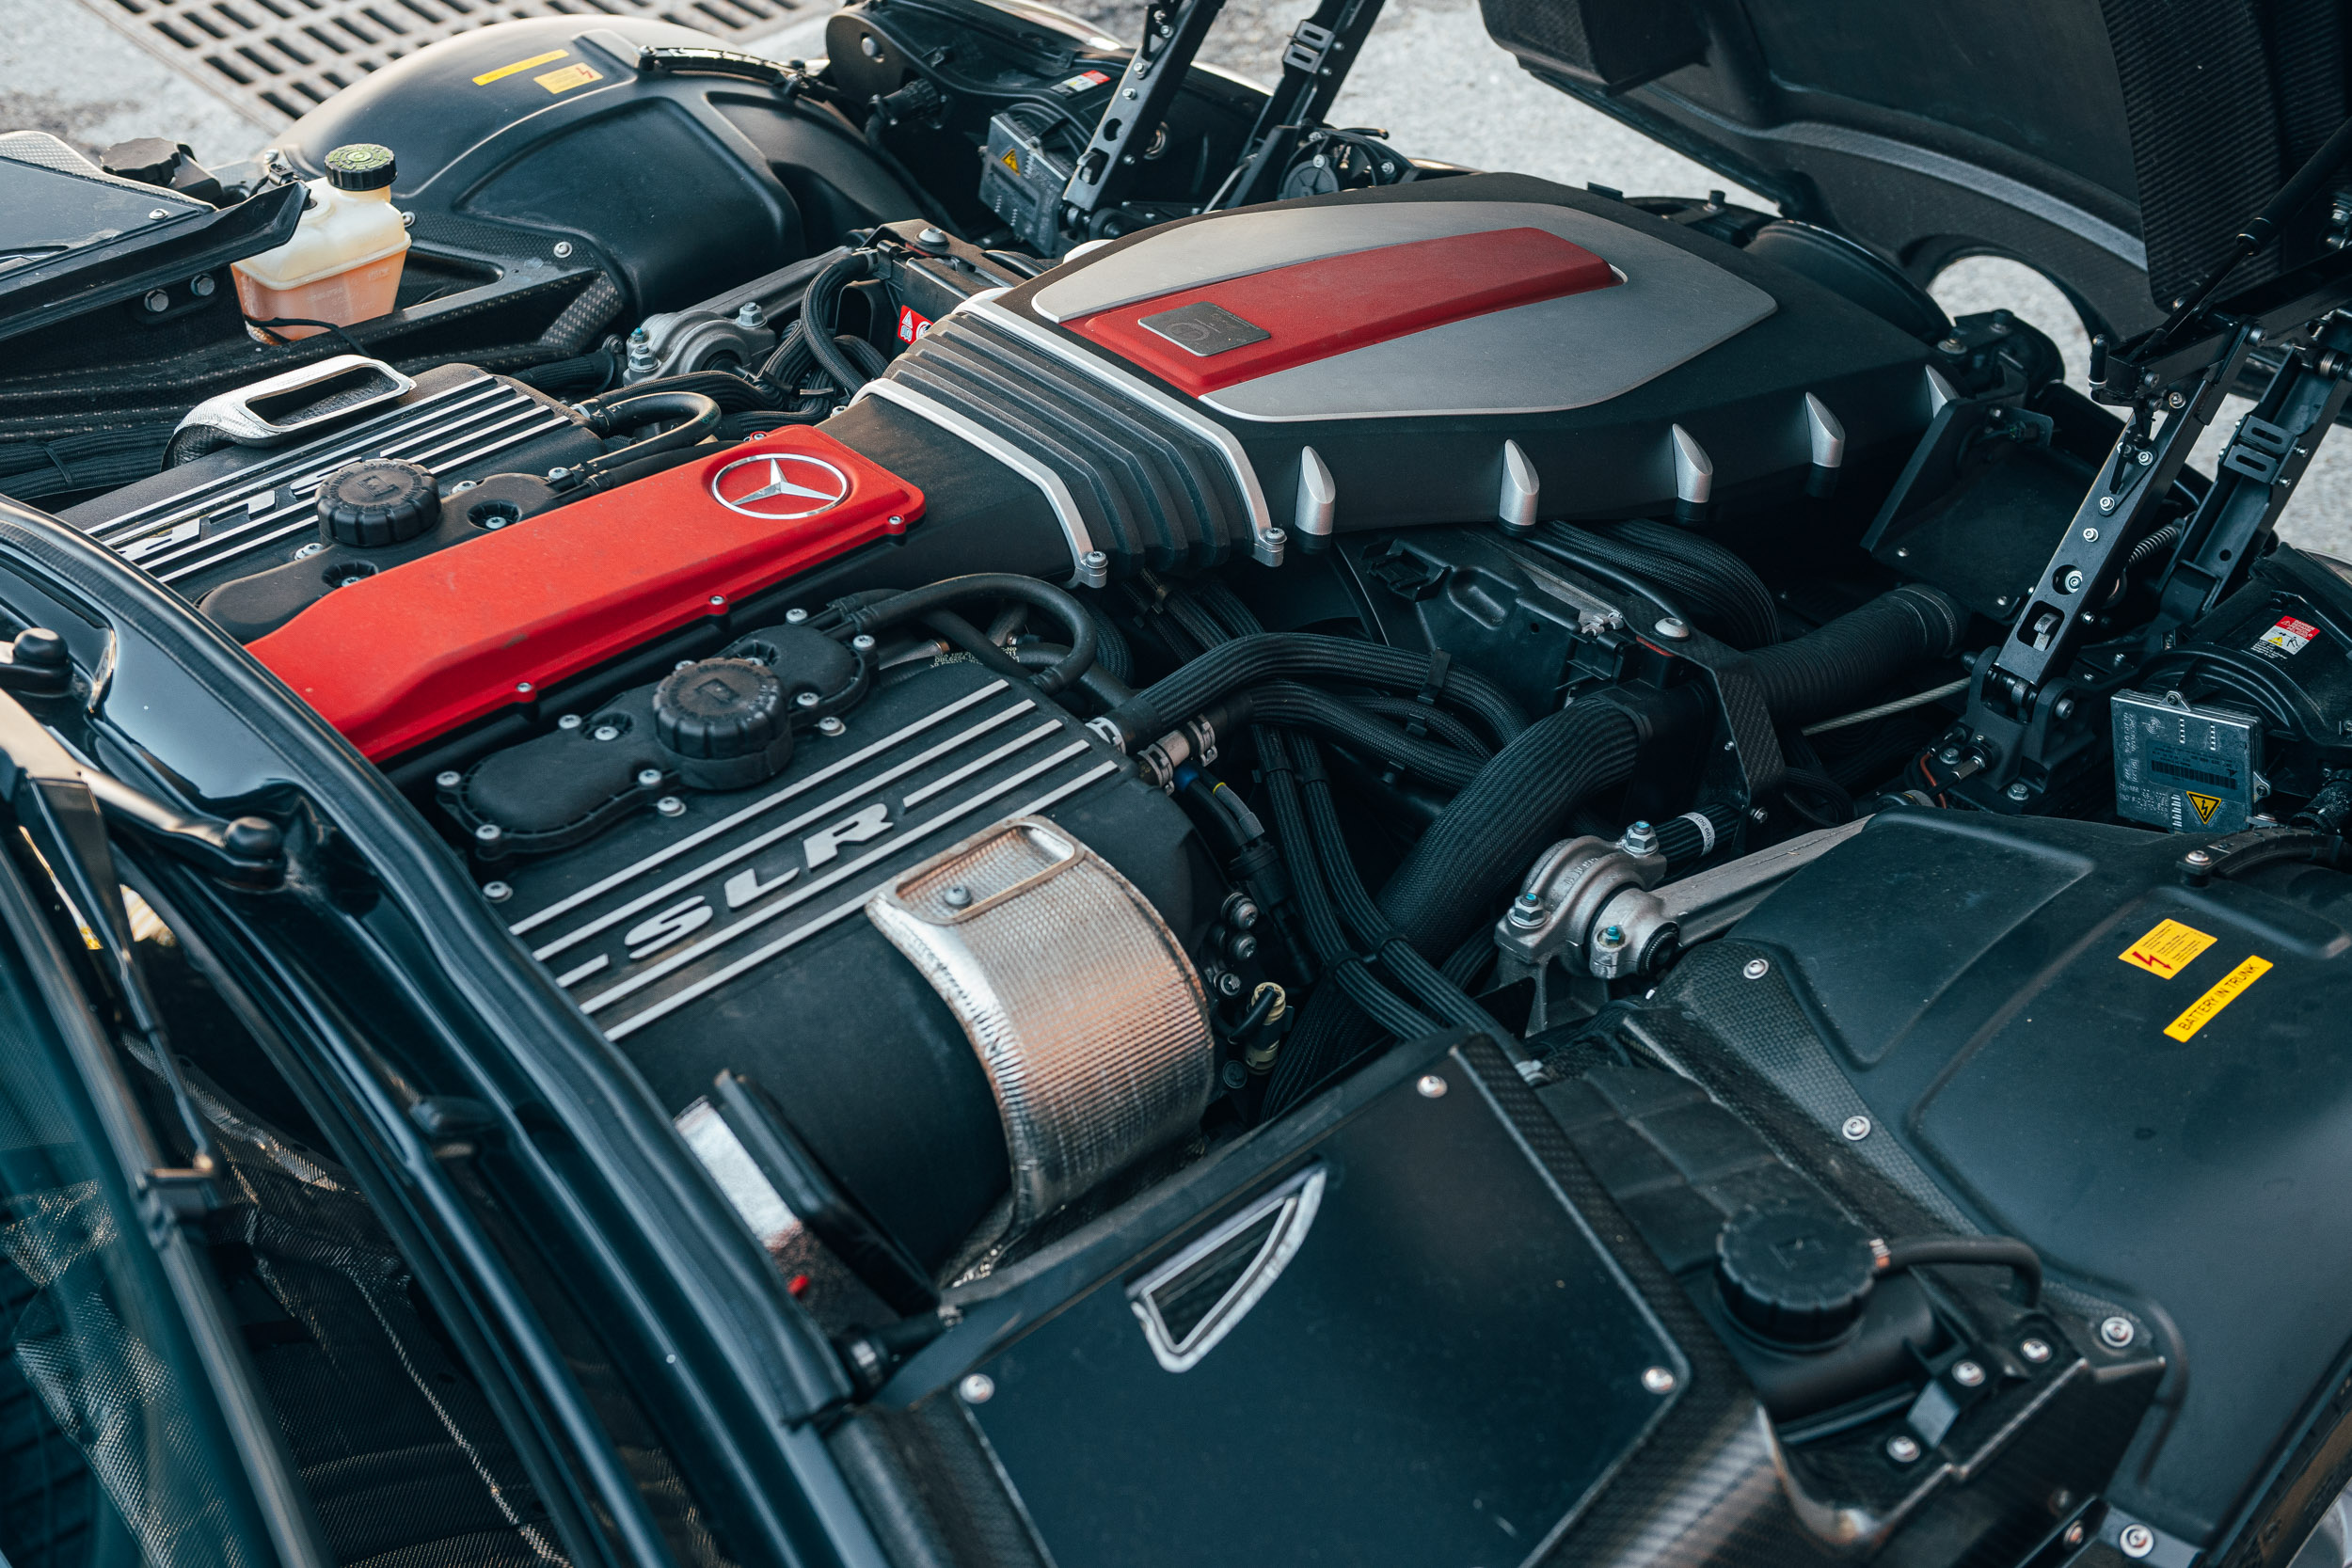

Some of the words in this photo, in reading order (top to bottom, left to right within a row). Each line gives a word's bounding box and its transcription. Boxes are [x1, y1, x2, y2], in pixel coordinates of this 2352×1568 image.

[625, 803, 894, 958] SLR
[2178, 996, 2219, 1031] BATTERY
[2214, 988, 2231, 999] IN
[2224, 963, 2260, 989] TRUNK
